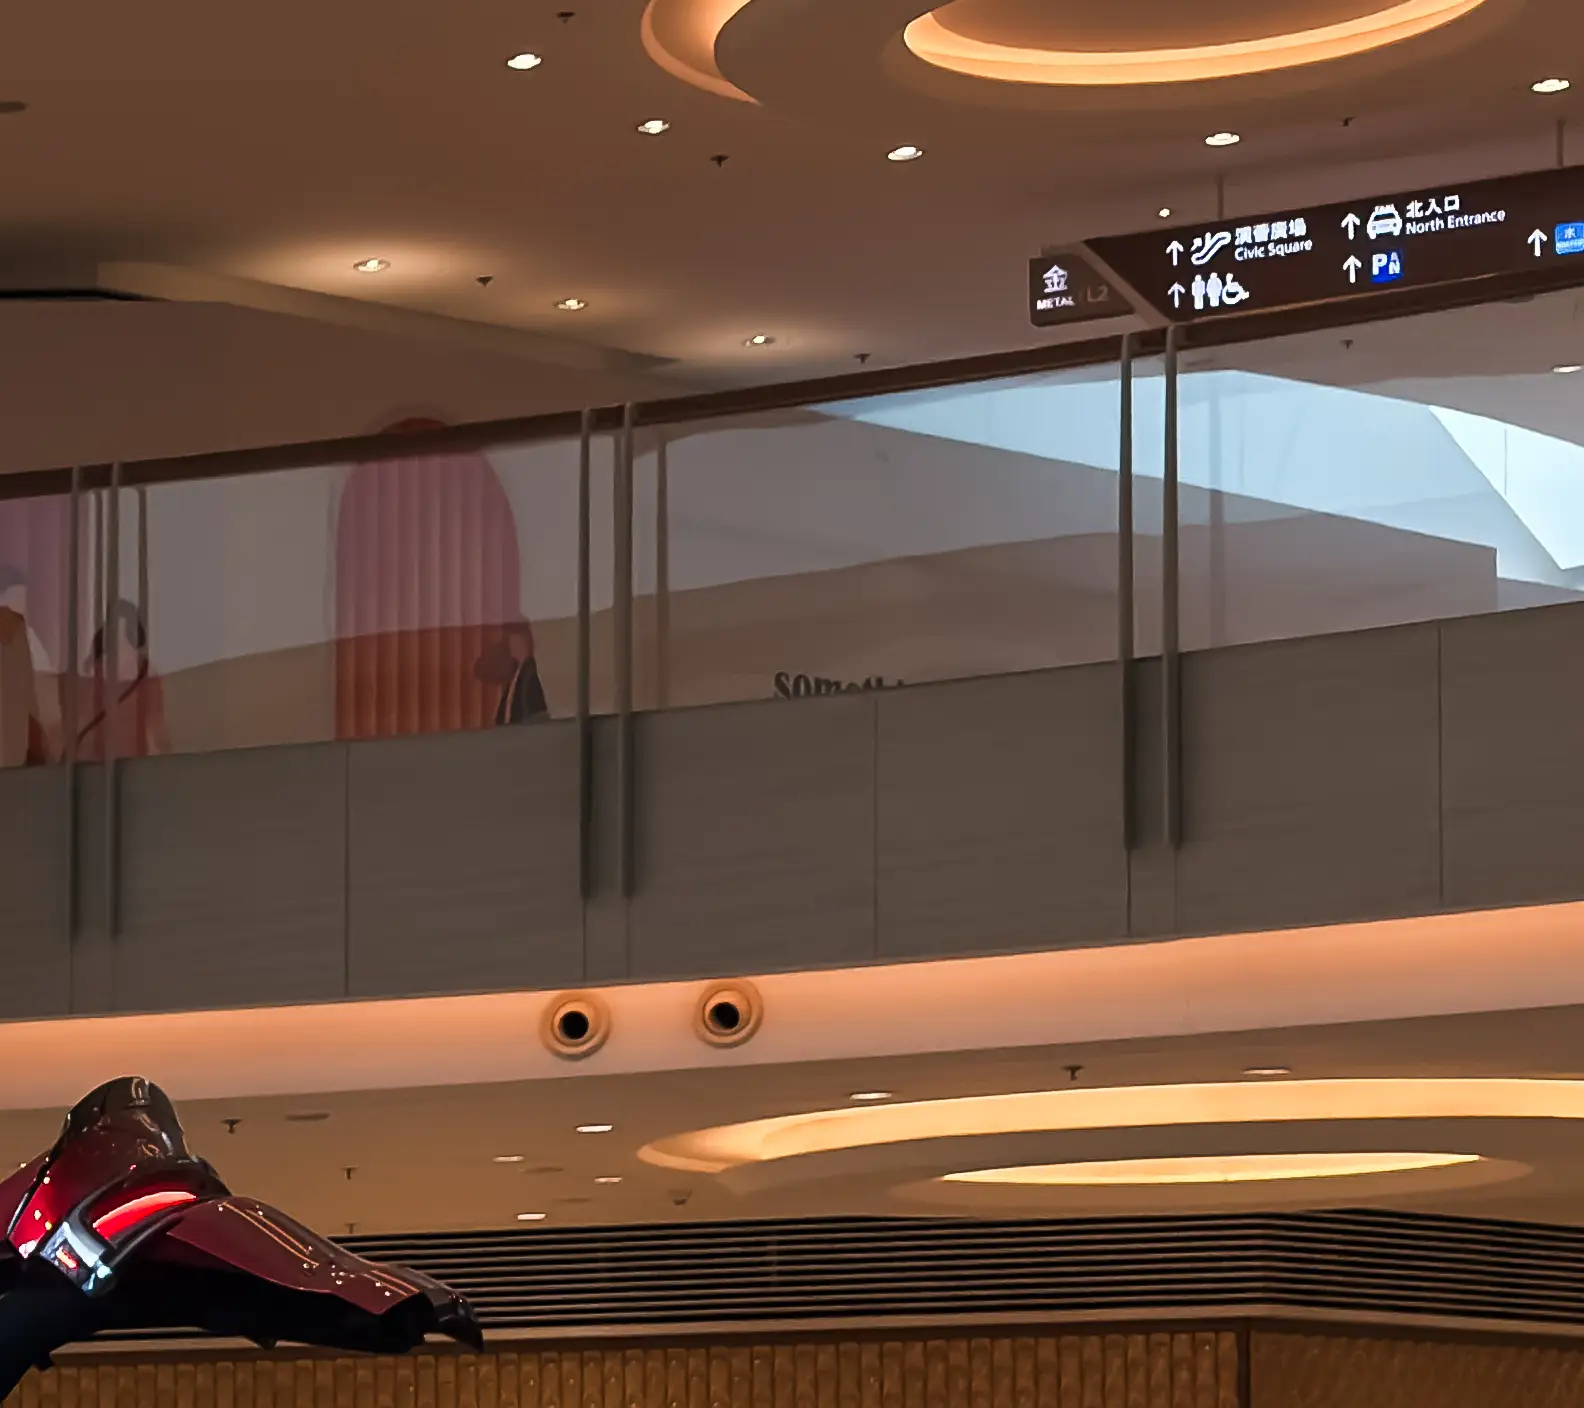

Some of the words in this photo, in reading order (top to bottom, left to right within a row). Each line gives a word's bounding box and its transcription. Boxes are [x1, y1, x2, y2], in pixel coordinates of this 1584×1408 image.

[1405, 195, 1460, 218] 北入口
[1405, 217, 1444, 235] North
[1447, 210, 1506, 229] Entrance
[1234, 246, 1265, 261] Civic
[1268, 239, 1313, 257] Square
[1036, 296, 1076, 311] METAL
